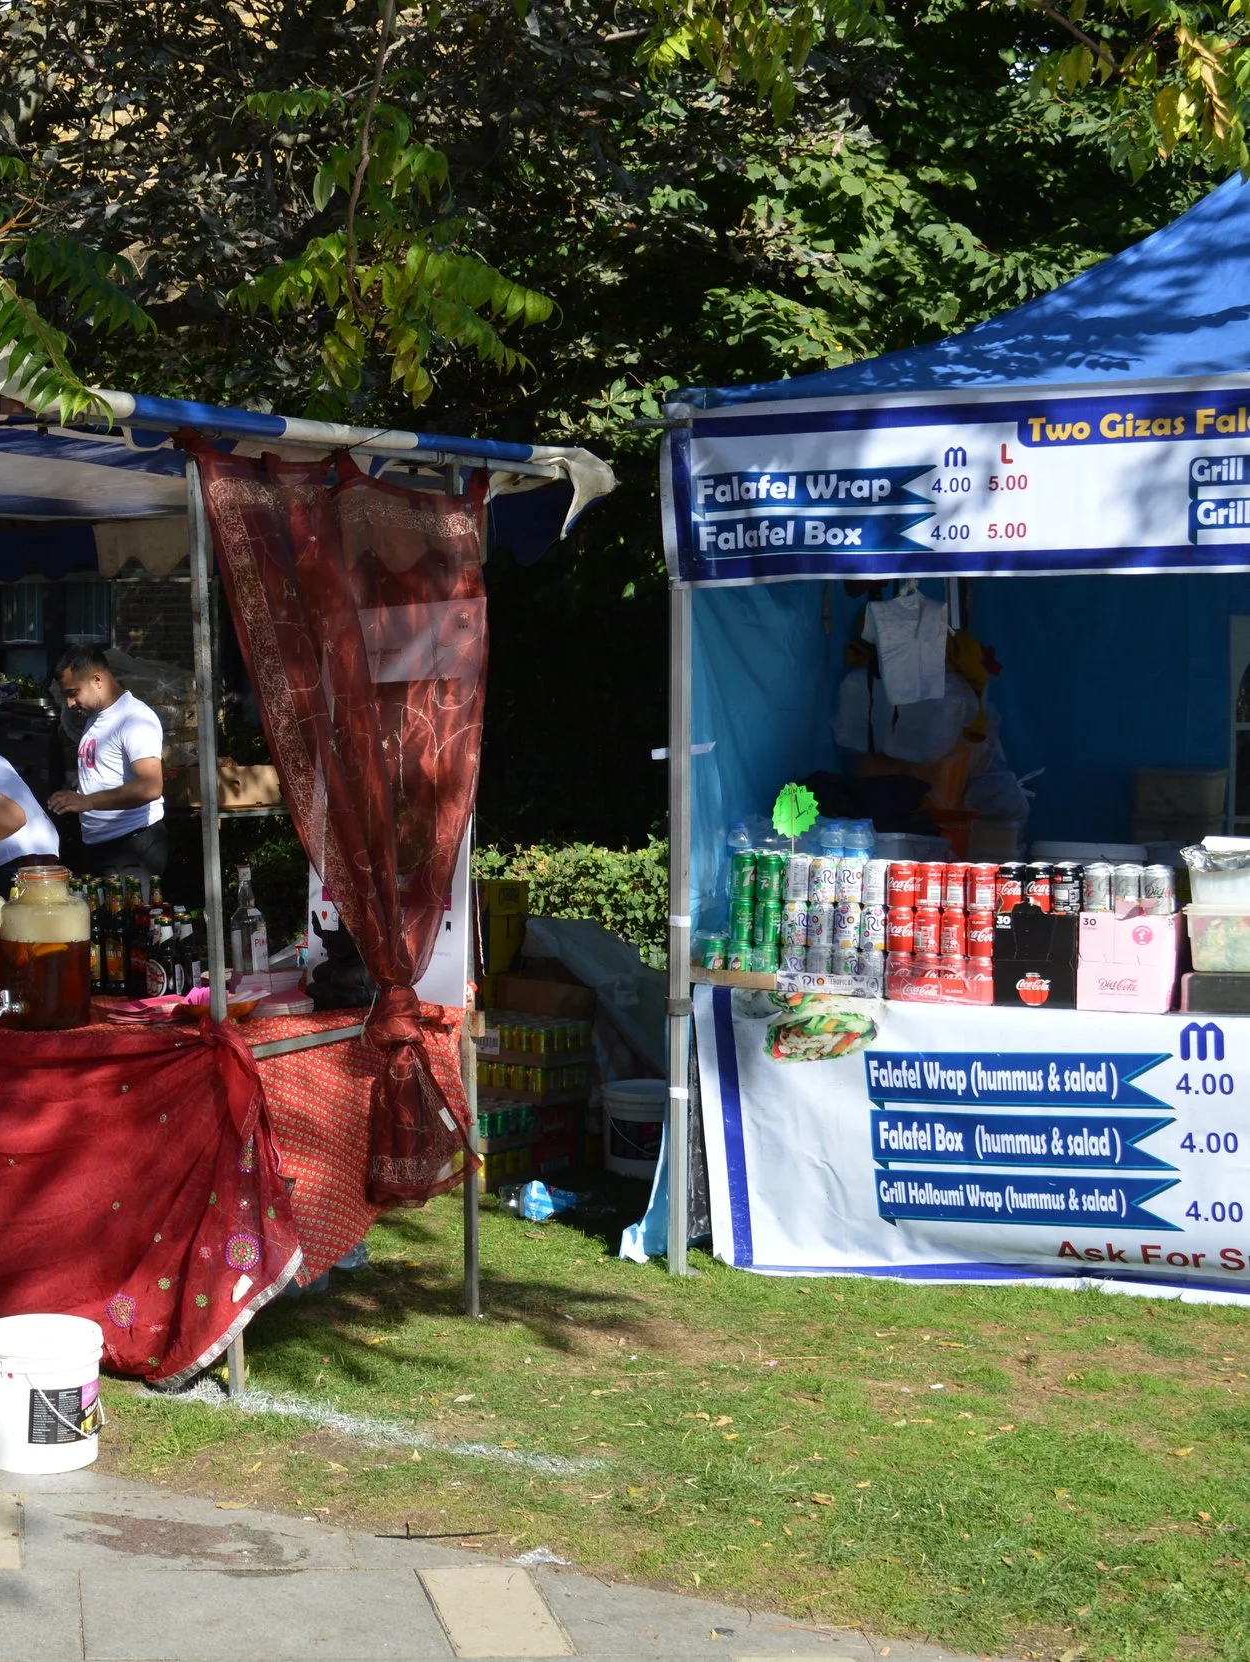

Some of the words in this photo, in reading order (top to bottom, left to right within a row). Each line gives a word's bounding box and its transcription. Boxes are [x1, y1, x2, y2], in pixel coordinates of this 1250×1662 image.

[1028, 417, 1091, 442] Two
[1099, 412, 1185, 438] Gizas
[1001, 443, 1013, 464] L
[1191, 457, 1243, 482] Grill
[697, 475, 796, 505] Falafel
[805, 474, 891, 503] Wrap
[931, 477, 971, 493] 4.00
[988, 475, 1028, 491] 5.00
[699, 520, 795, 551] Falafel
[804, 521, 862, 546] Box
[930, 525, 970, 541] 4.00
[987, 523, 1027, 539] 5.00
[996, 915, 1011, 925] 30
[1082, 917, 1097, 926] 30
[869, 1060, 921, 1088] Falafel
[923, 1062, 967, 1095] Wrap
[970, 1061, 1043, 1097] (hummus
[1048, 1062, 1060, 1091] &
[1175, 1073, 1234, 1095] 4.00
[879, 1121, 931, 1150] Falafel
[934, 1123, 964, 1151] Box
[975, 1124, 1047, 1160] (hummus
[1051, 1127, 1064, 1155] &
[1180, 1132, 1238, 1153] 4.00
[879, 1180, 906, 1204] Grill
[966, 1185, 1003, 1212] Wrap
[1005, 1185, 1065, 1214] (hummus
[1068, 1188, 1080, 1211] &
[1185, 1201, 1243, 1222] 4.00
[1058, 1240, 1130, 1264] Ask
[1140, 1244, 1206, 1268] For
[1220, 1247, 1250, 1271] S
